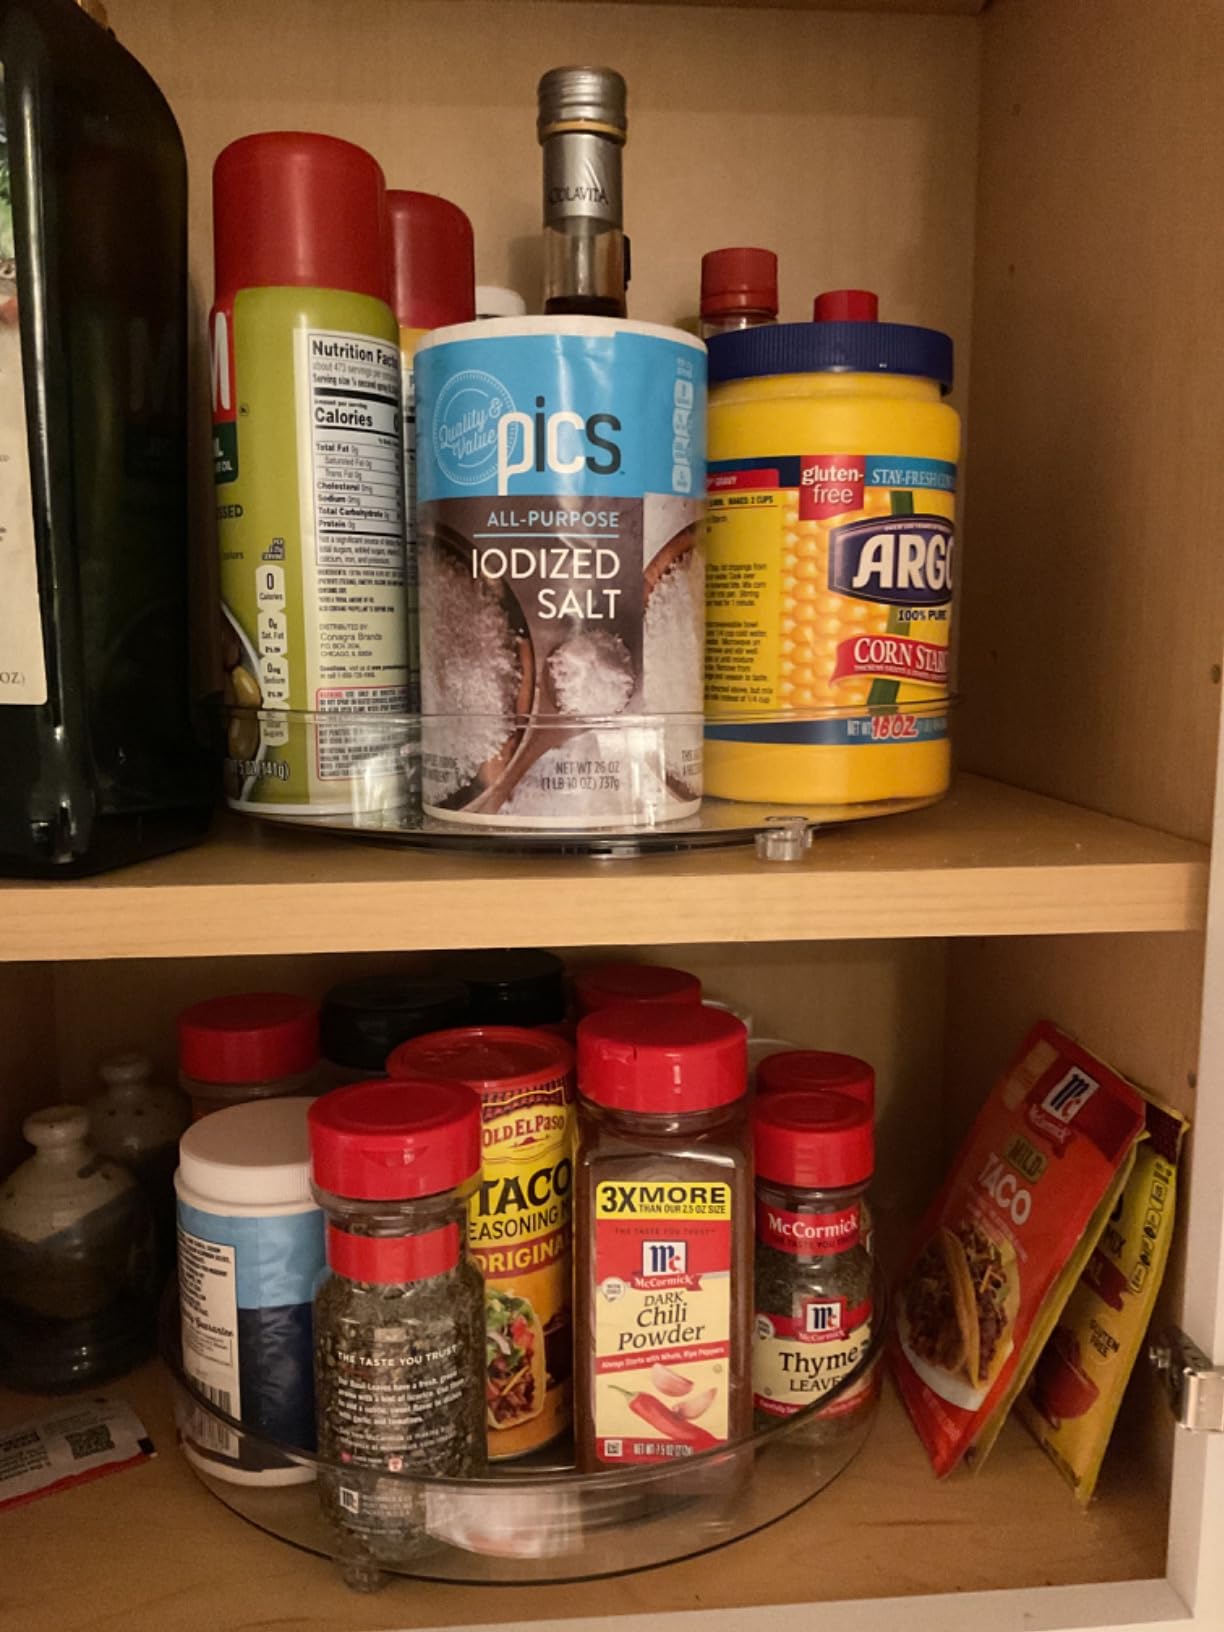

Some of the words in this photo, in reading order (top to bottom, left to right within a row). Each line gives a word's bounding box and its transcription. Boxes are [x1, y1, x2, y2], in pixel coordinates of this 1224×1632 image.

[548, 186, 608, 205] OLAVITA
[313, 340, 373, 361] Nutrition
[315, 407, 373, 427] Calories
[438, 411, 485, 450] Quality
[490, 398, 503, 418] &
[337, 445, 349, 453] Fat
[453, 429, 496, 459] Value
[497, 395, 622, 496] pics
[801, 464, 864, 485] gluten-
[813, 486, 853, 504] free
[486, 511, 619, 528] ALL-PURPOSE
[472, 548, 620, 579] IODIZED
[538, 589, 622, 620] SALT
[898, 610, 925, 622] 100%
[854, 637, 912, 666] CORN
[555, 762, 574, 774] NET
[576, 761, 592, 774] WT
[594, 761, 606, 773] 26
[608, 761, 620, 773] OZ
[483, 1125, 513, 1147] OLD
[515, 1119, 534, 1137] EL
[478, 1157, 570, 1216] TACO
[978, 1152, 1031, 1225] TACO
[601, 1186, 637, 1213] 3X
[639, 1187, 725, 1204] MORE
[640, 1205, 662, 1213] THAN
[664, 1205, 681, 1213] OUR
[683, 1205, 694, 1213] 2.5
[695, 1205, 706, 1213] OZ
[708, 1205, 726, 1214] SIZE
[470, 1205, 559, 1240] EASONING
[768, 1213, 858, 1239] McCormick
[480, 1234, 566, 1272] ORIGINA
[634, 1275, 693, 1289] McCormick
[644, 1291, 684, 1307] DARK
[636, 1303, 688, 1327] Chili
[617, 1324, 706, 1351] Powder
[337, 1351, 355, 1364] THE
[359, 1357, 394, 1366] TASTE
[400, 1357, 423, 1366] YOU
[426, 1344, 458, 1362] TRUST
[602, 1359, 624, 1368] Always
[625, 1358, 645, 1366] Starts
[646, 1355, 660, 1363] with
[698, 1347, 725, 1356] Peppers
[778, 1347, 858, 1379] Thyme
[789, 1376, 843, 1392] LEAVE
